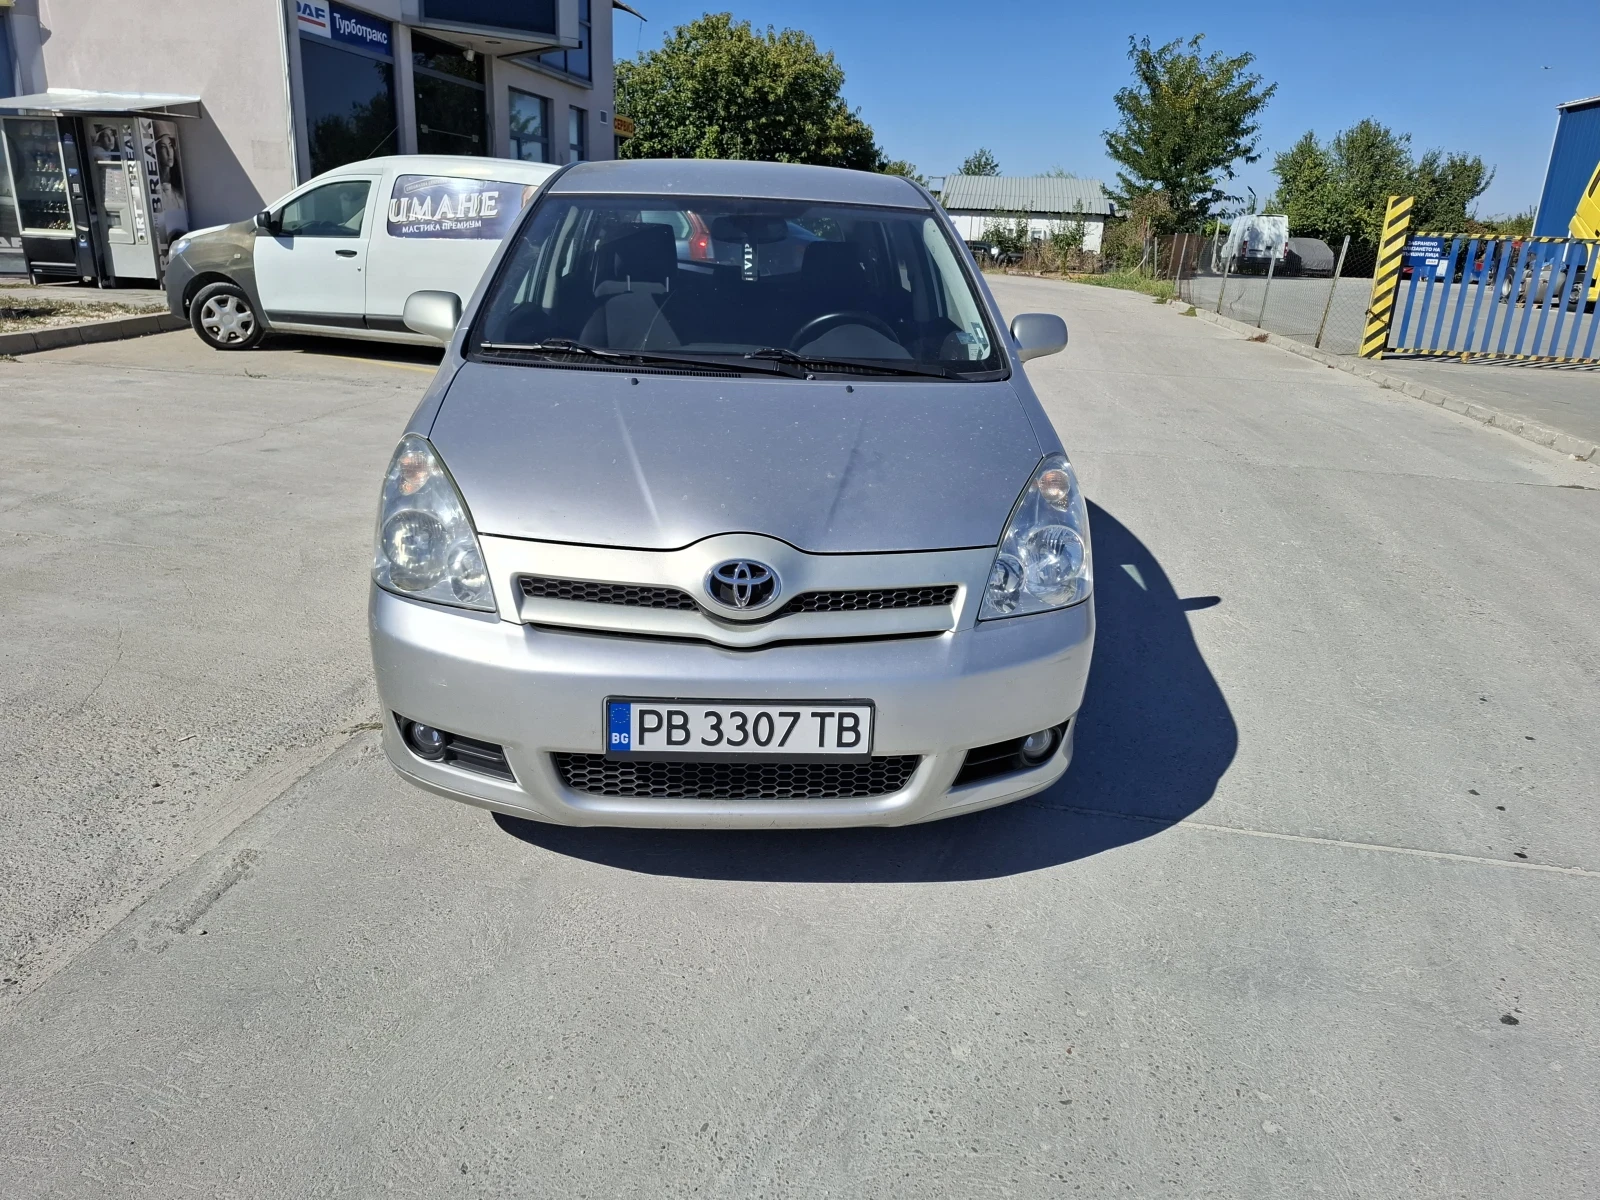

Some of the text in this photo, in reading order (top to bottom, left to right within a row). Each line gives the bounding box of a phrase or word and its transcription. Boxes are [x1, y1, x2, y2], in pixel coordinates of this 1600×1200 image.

[333, 13, 388, 44] Турботракс
[141, 118, 162, 213] BREAK
[402, 220, 482, 233] МАСТИКА ПРЕМИУМ
[744, 243, 753, 270] VIP
[611, 733, 629, 744] BG
[638, 709, 861, 748] PB 3307 TB
